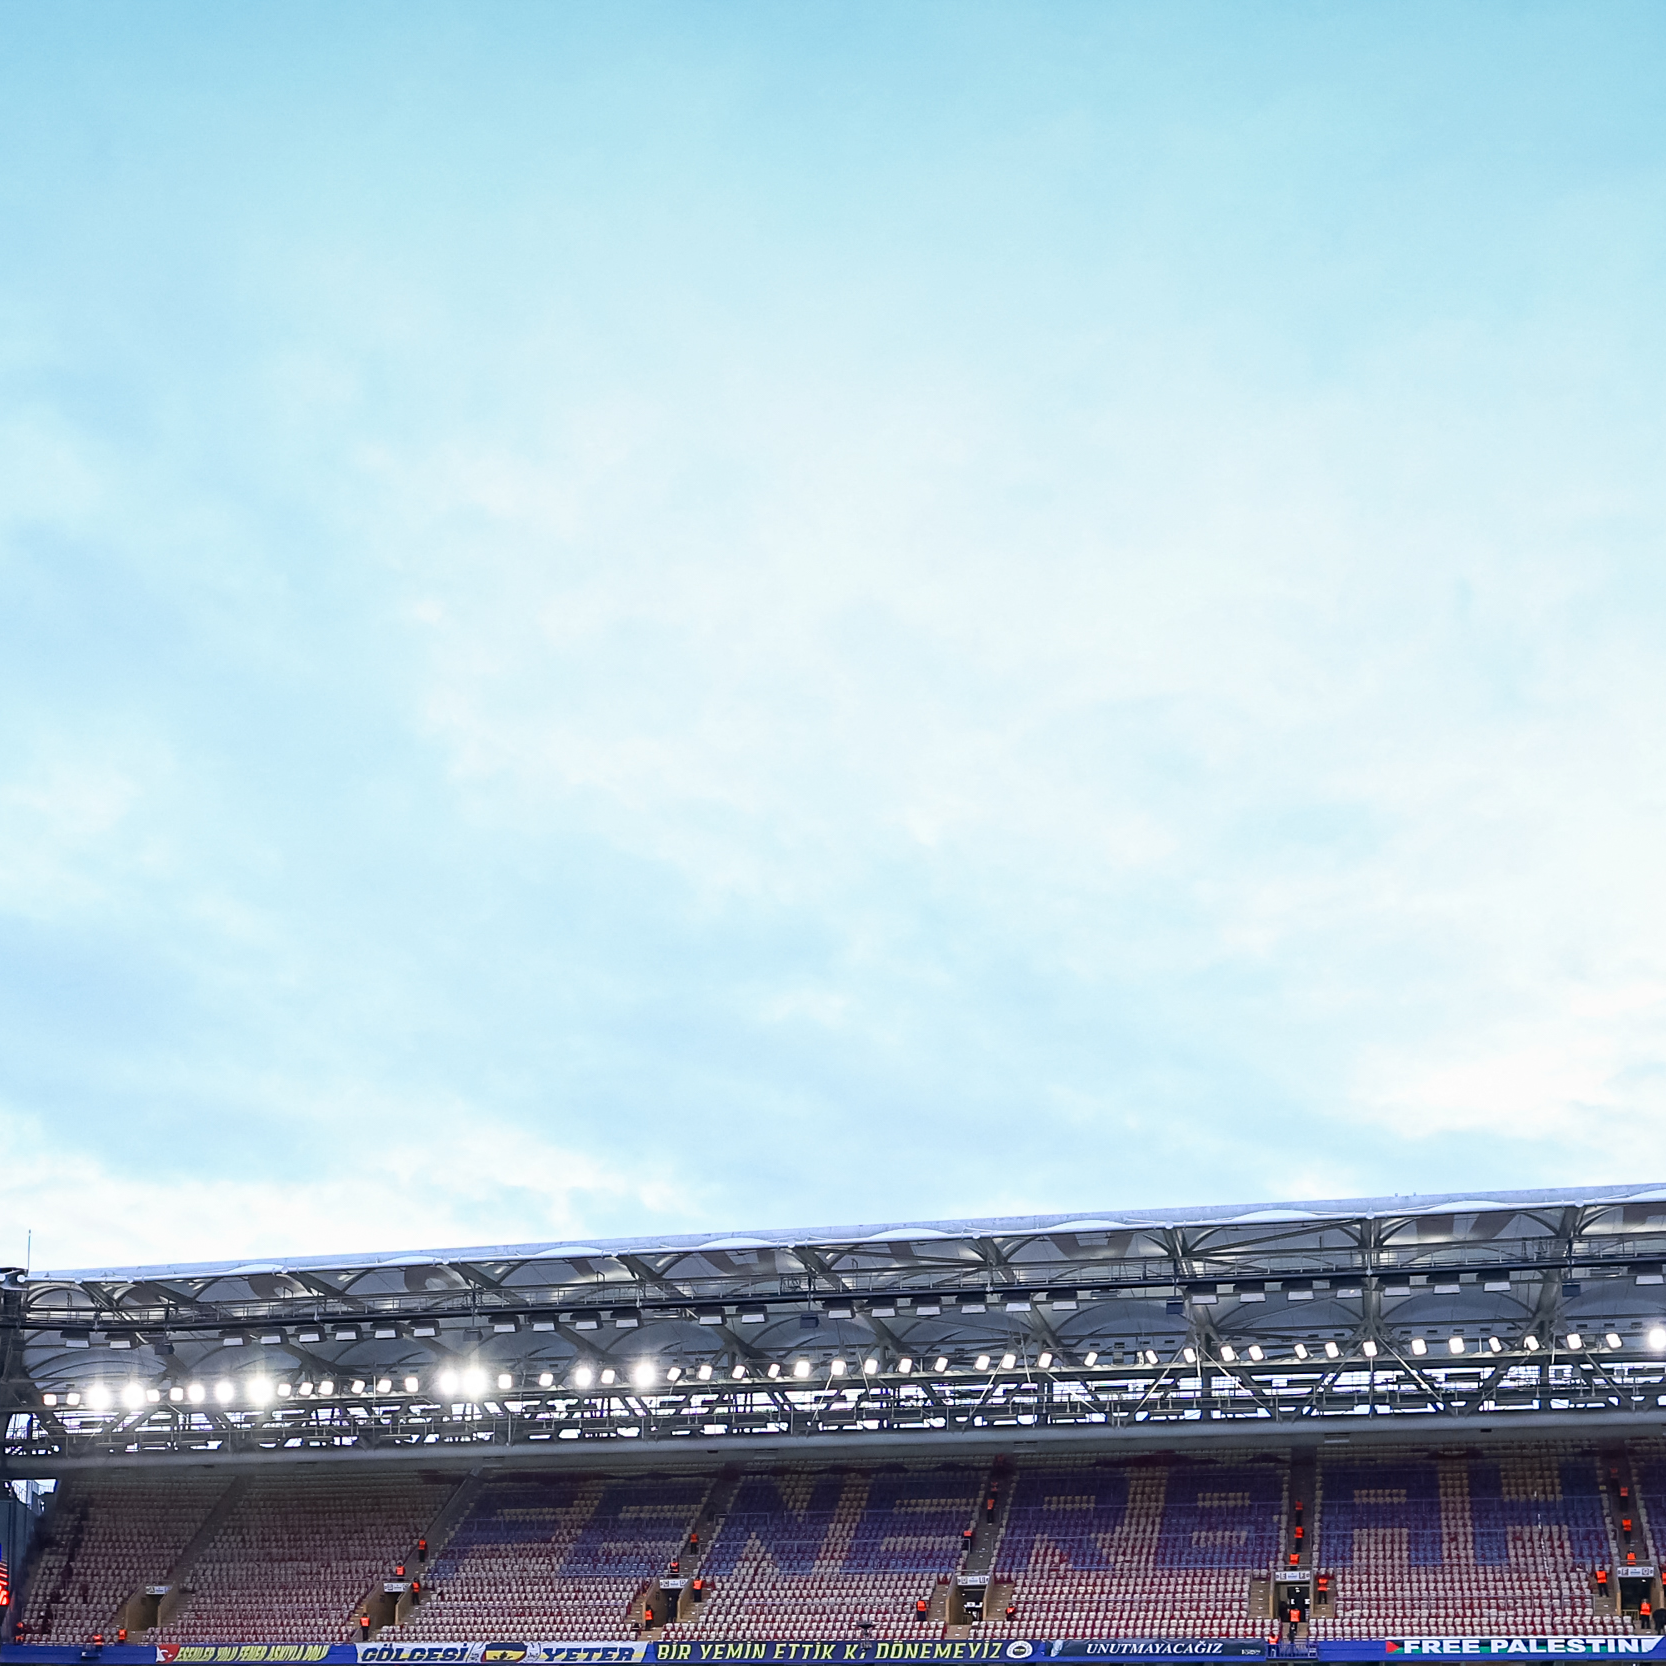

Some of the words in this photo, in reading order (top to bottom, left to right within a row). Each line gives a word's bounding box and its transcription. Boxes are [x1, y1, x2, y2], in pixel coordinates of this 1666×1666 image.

[657, 1643, 690, 1660] BİR
[699, 1640, 766, 1660] YEMİN
[773, 1641, 836, 1660] ETTİK
[874, 1641, 1004, 1660] DÖNEMEYİZ
[1086, 1640, 1223, 1655] UNUTMAYACAĞIZ
[1404, 1639, 1481, 1654] FREE
[537, 1647, 634, 1662] YETER
